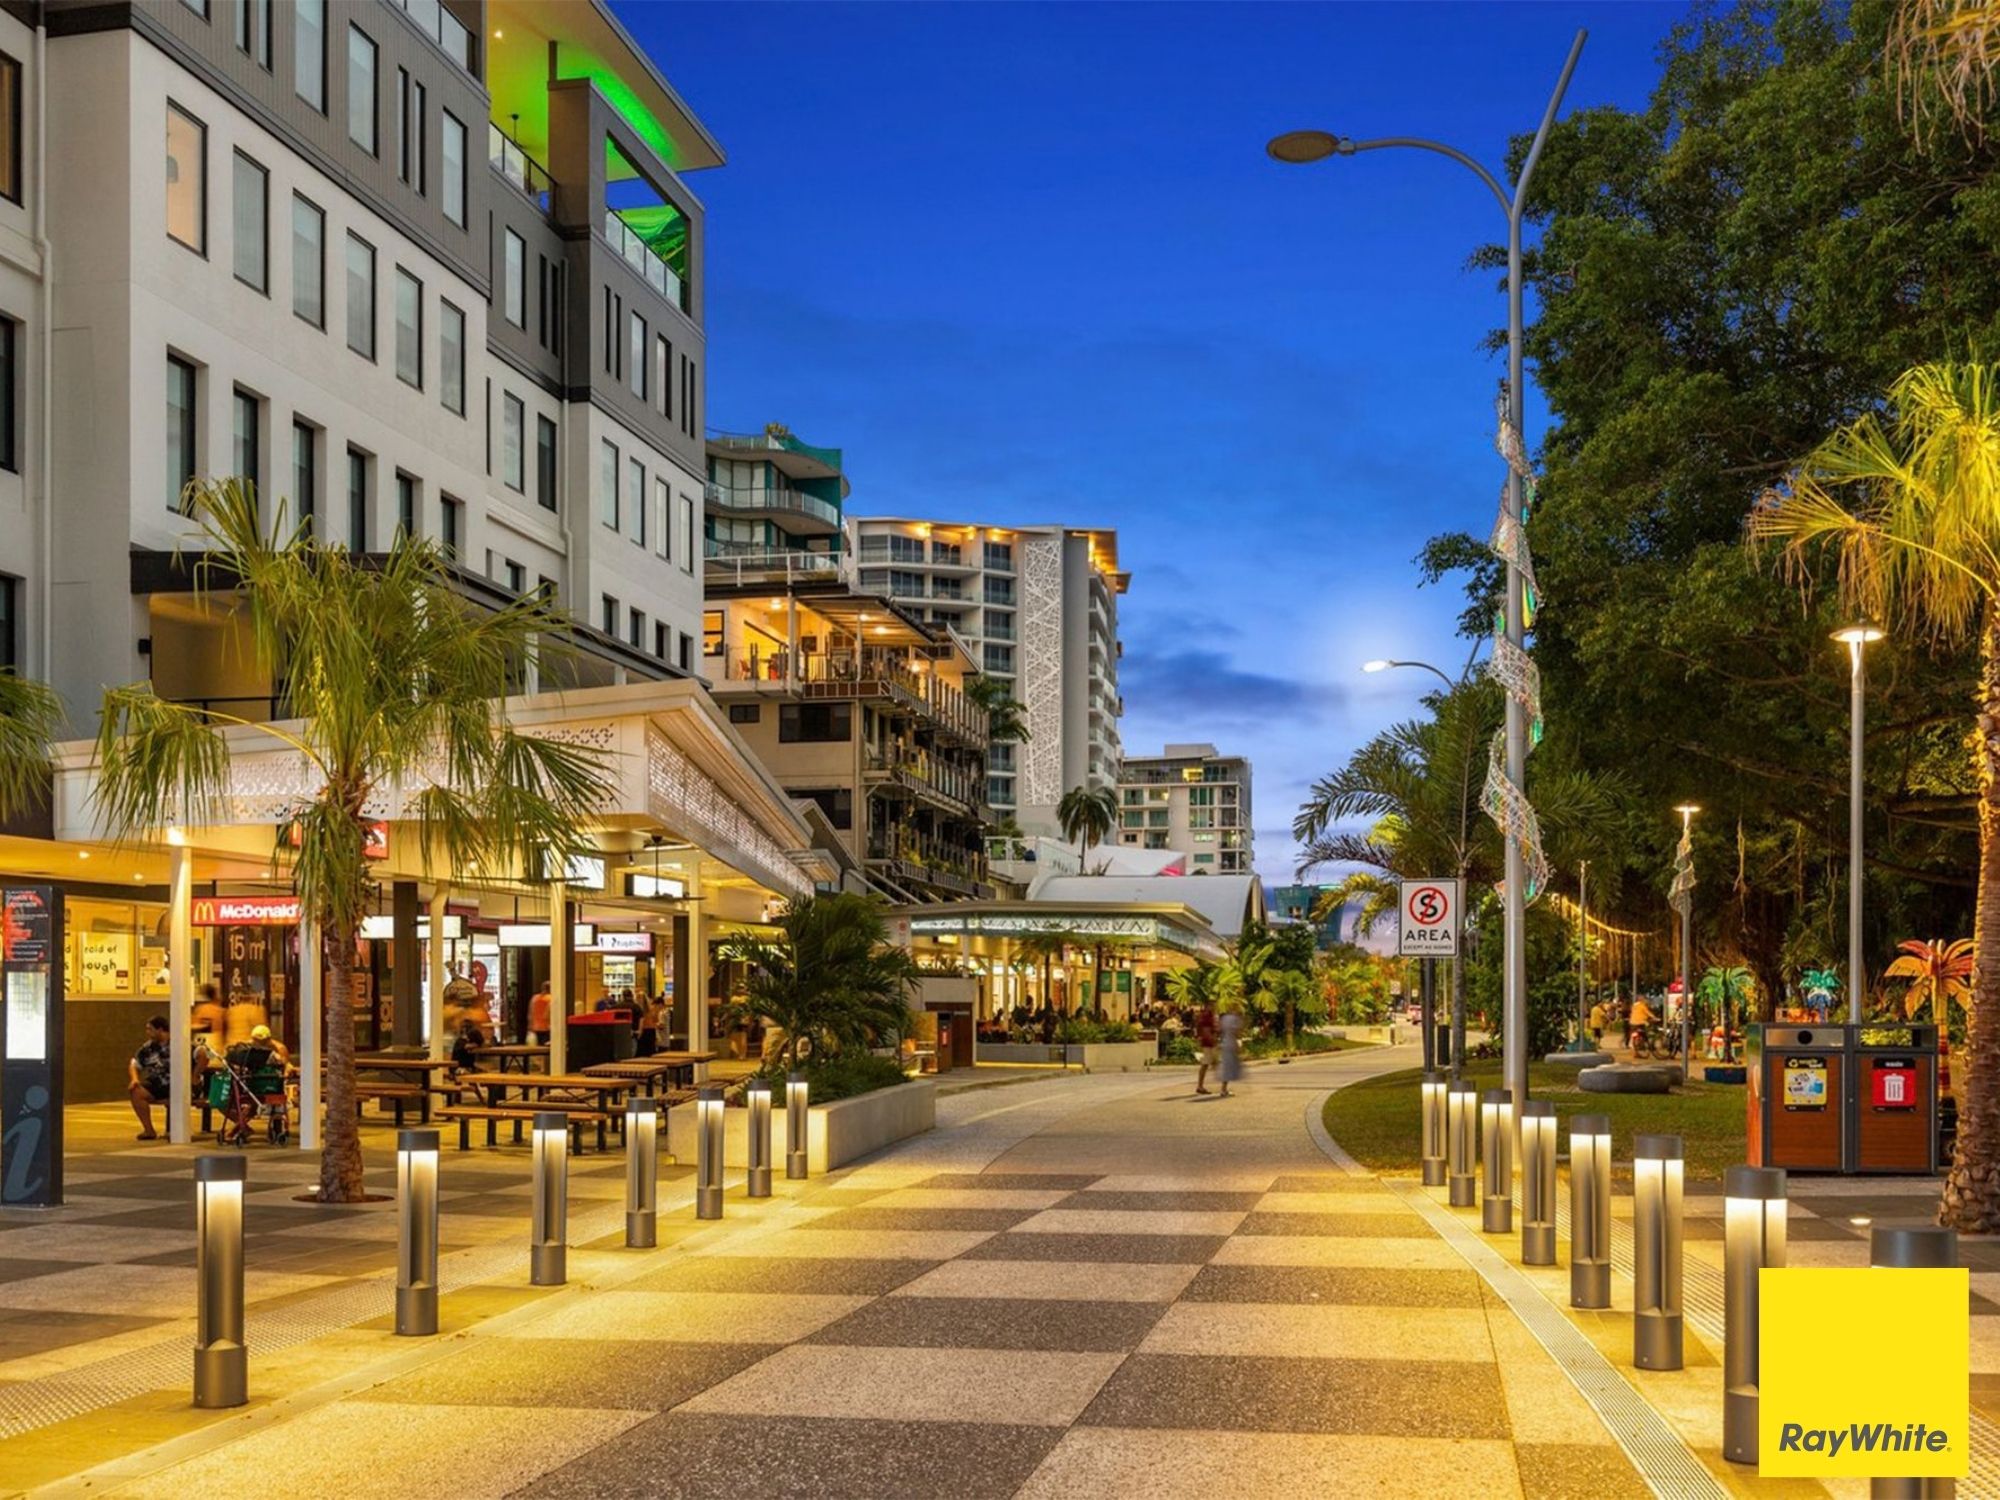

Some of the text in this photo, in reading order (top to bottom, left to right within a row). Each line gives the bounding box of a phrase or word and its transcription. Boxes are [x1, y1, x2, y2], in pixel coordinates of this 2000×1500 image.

[1405, 929, 1452, 941] AREA
[229, 935, 245, 960] 15
[232, 967, 242, 987] &
